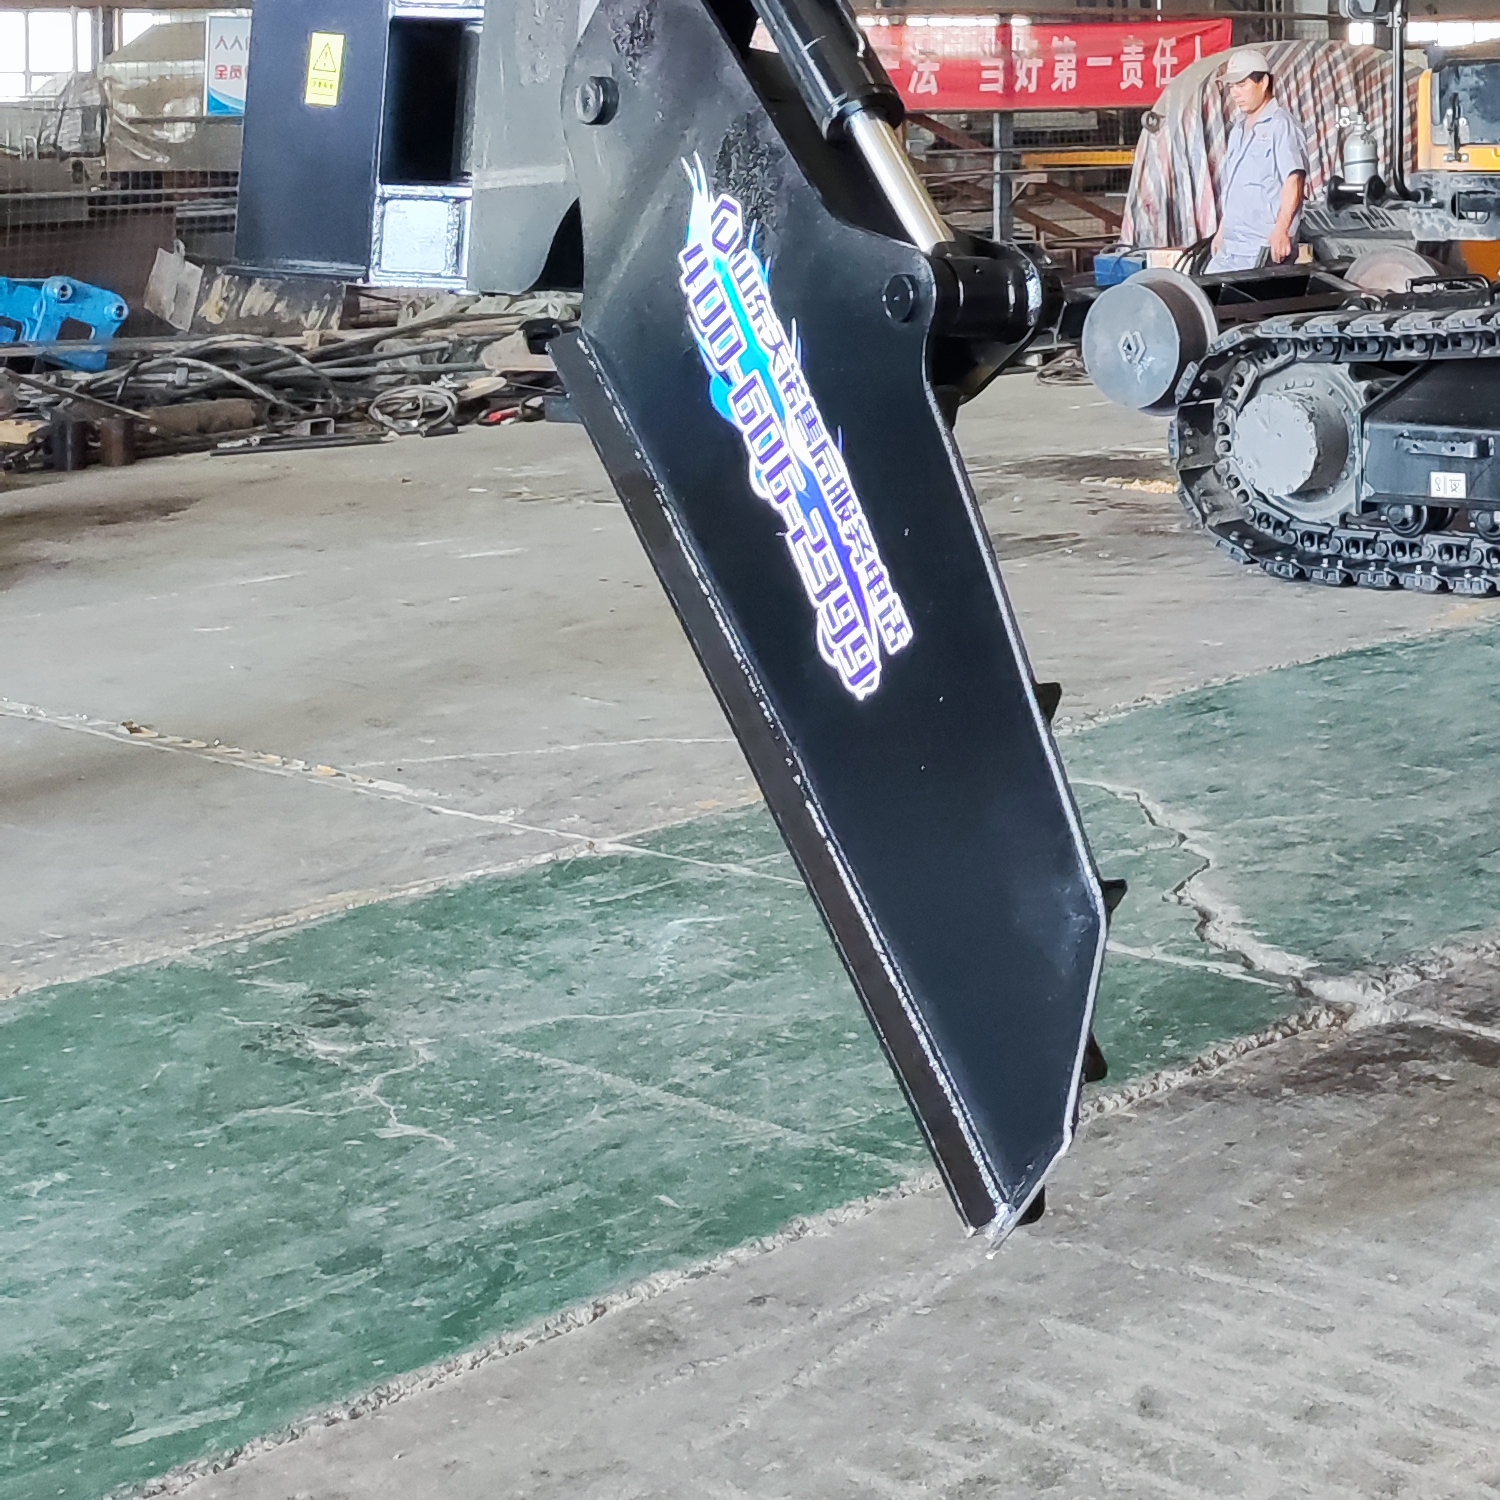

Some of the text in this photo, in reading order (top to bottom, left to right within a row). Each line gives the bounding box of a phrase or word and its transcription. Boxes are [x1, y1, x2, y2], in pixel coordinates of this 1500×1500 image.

[214, 35, 249, 51] 人人
[214, 64, 247, 80] 全员
[682, 242, 878, 690] 400-606-2399
[729, 249, 911, 651] 山东天诺售后服务电话
